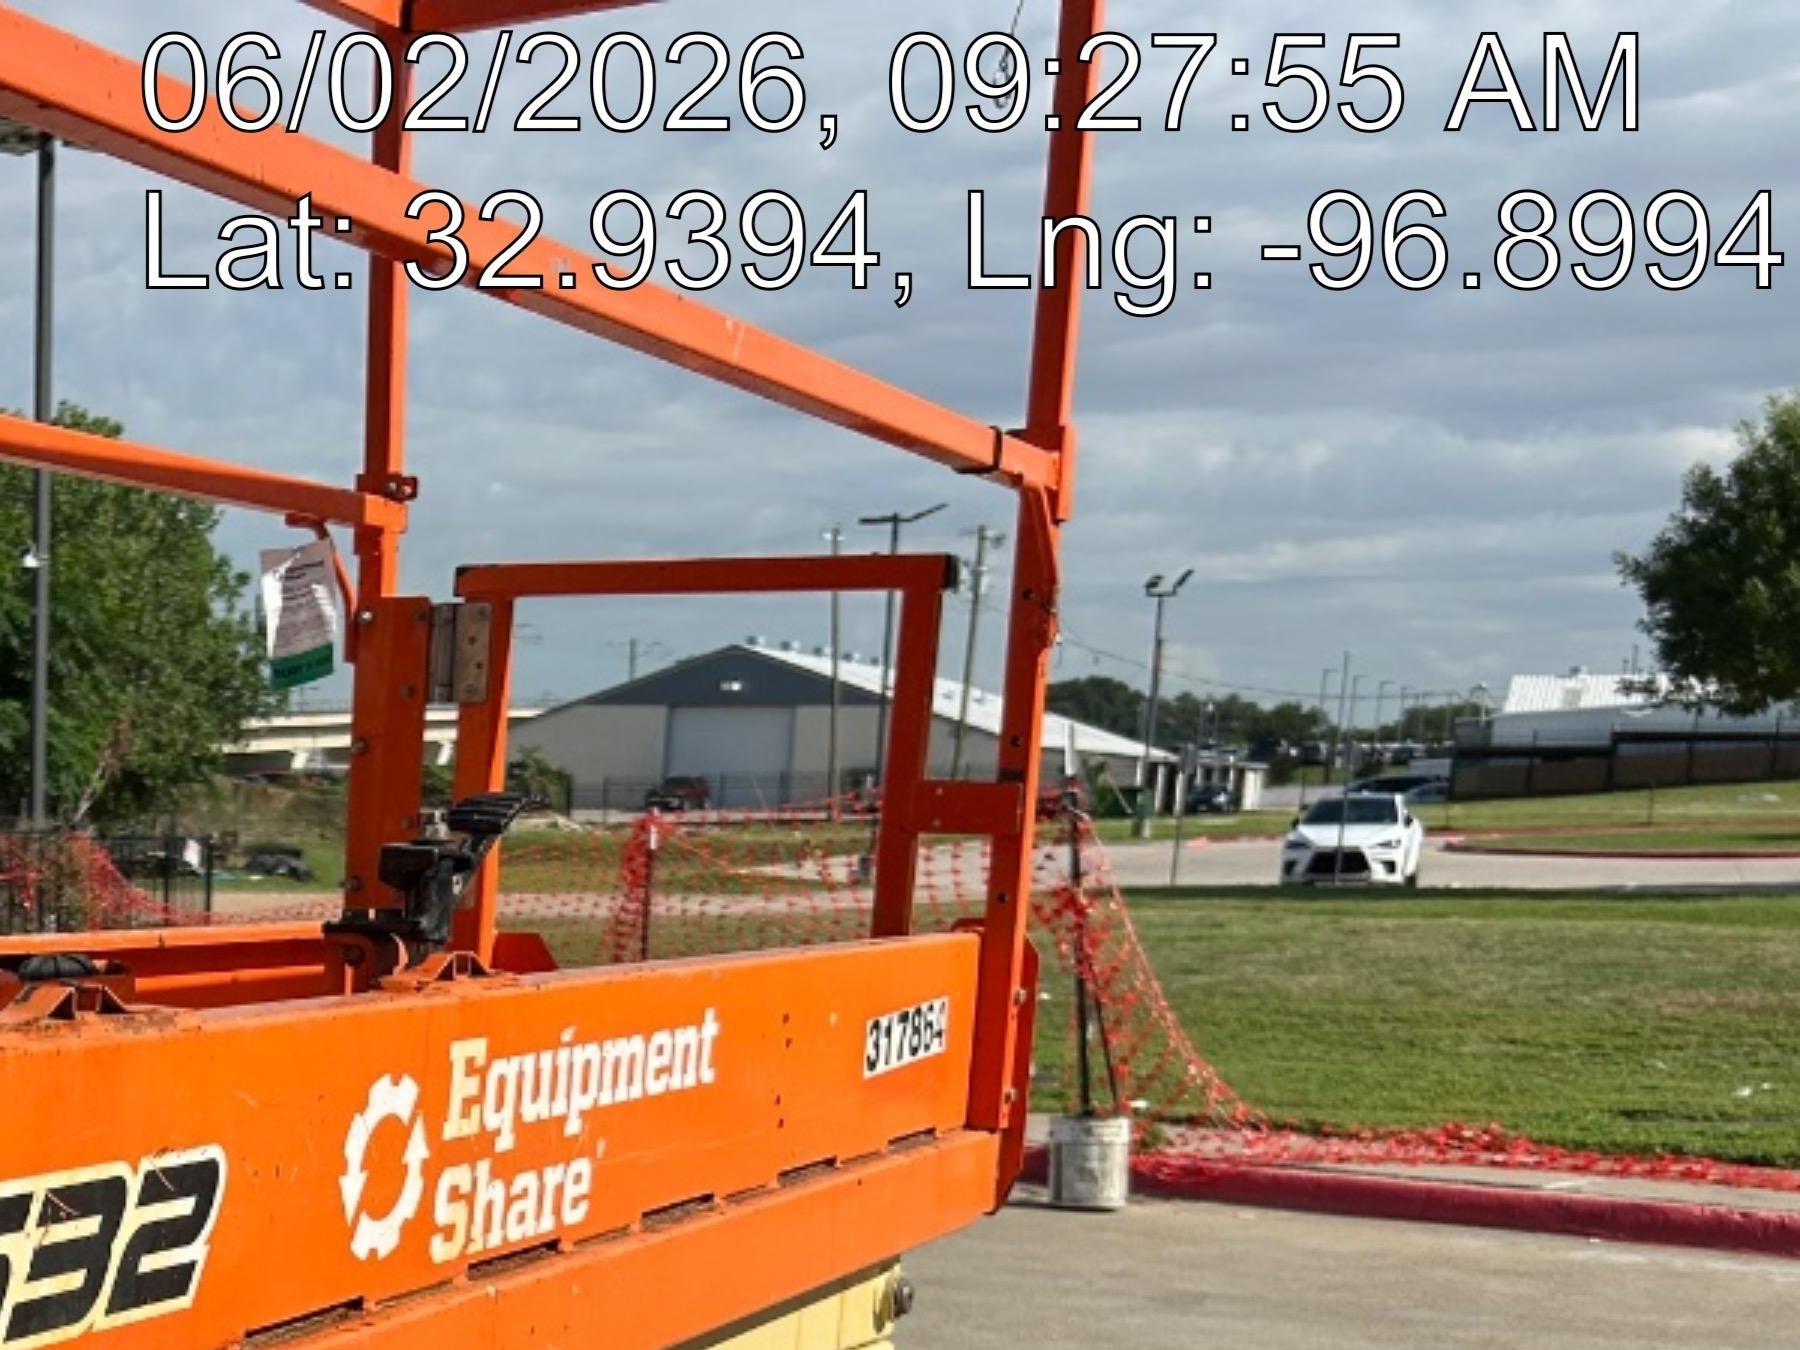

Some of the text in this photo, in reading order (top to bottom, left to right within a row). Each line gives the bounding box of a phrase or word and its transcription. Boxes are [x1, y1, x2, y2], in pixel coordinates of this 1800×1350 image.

[442, 1007, 721, 1151] Equipment
[866, 1000, 946, 1072] 317864
[430, 1154, 592, 1264] Share
